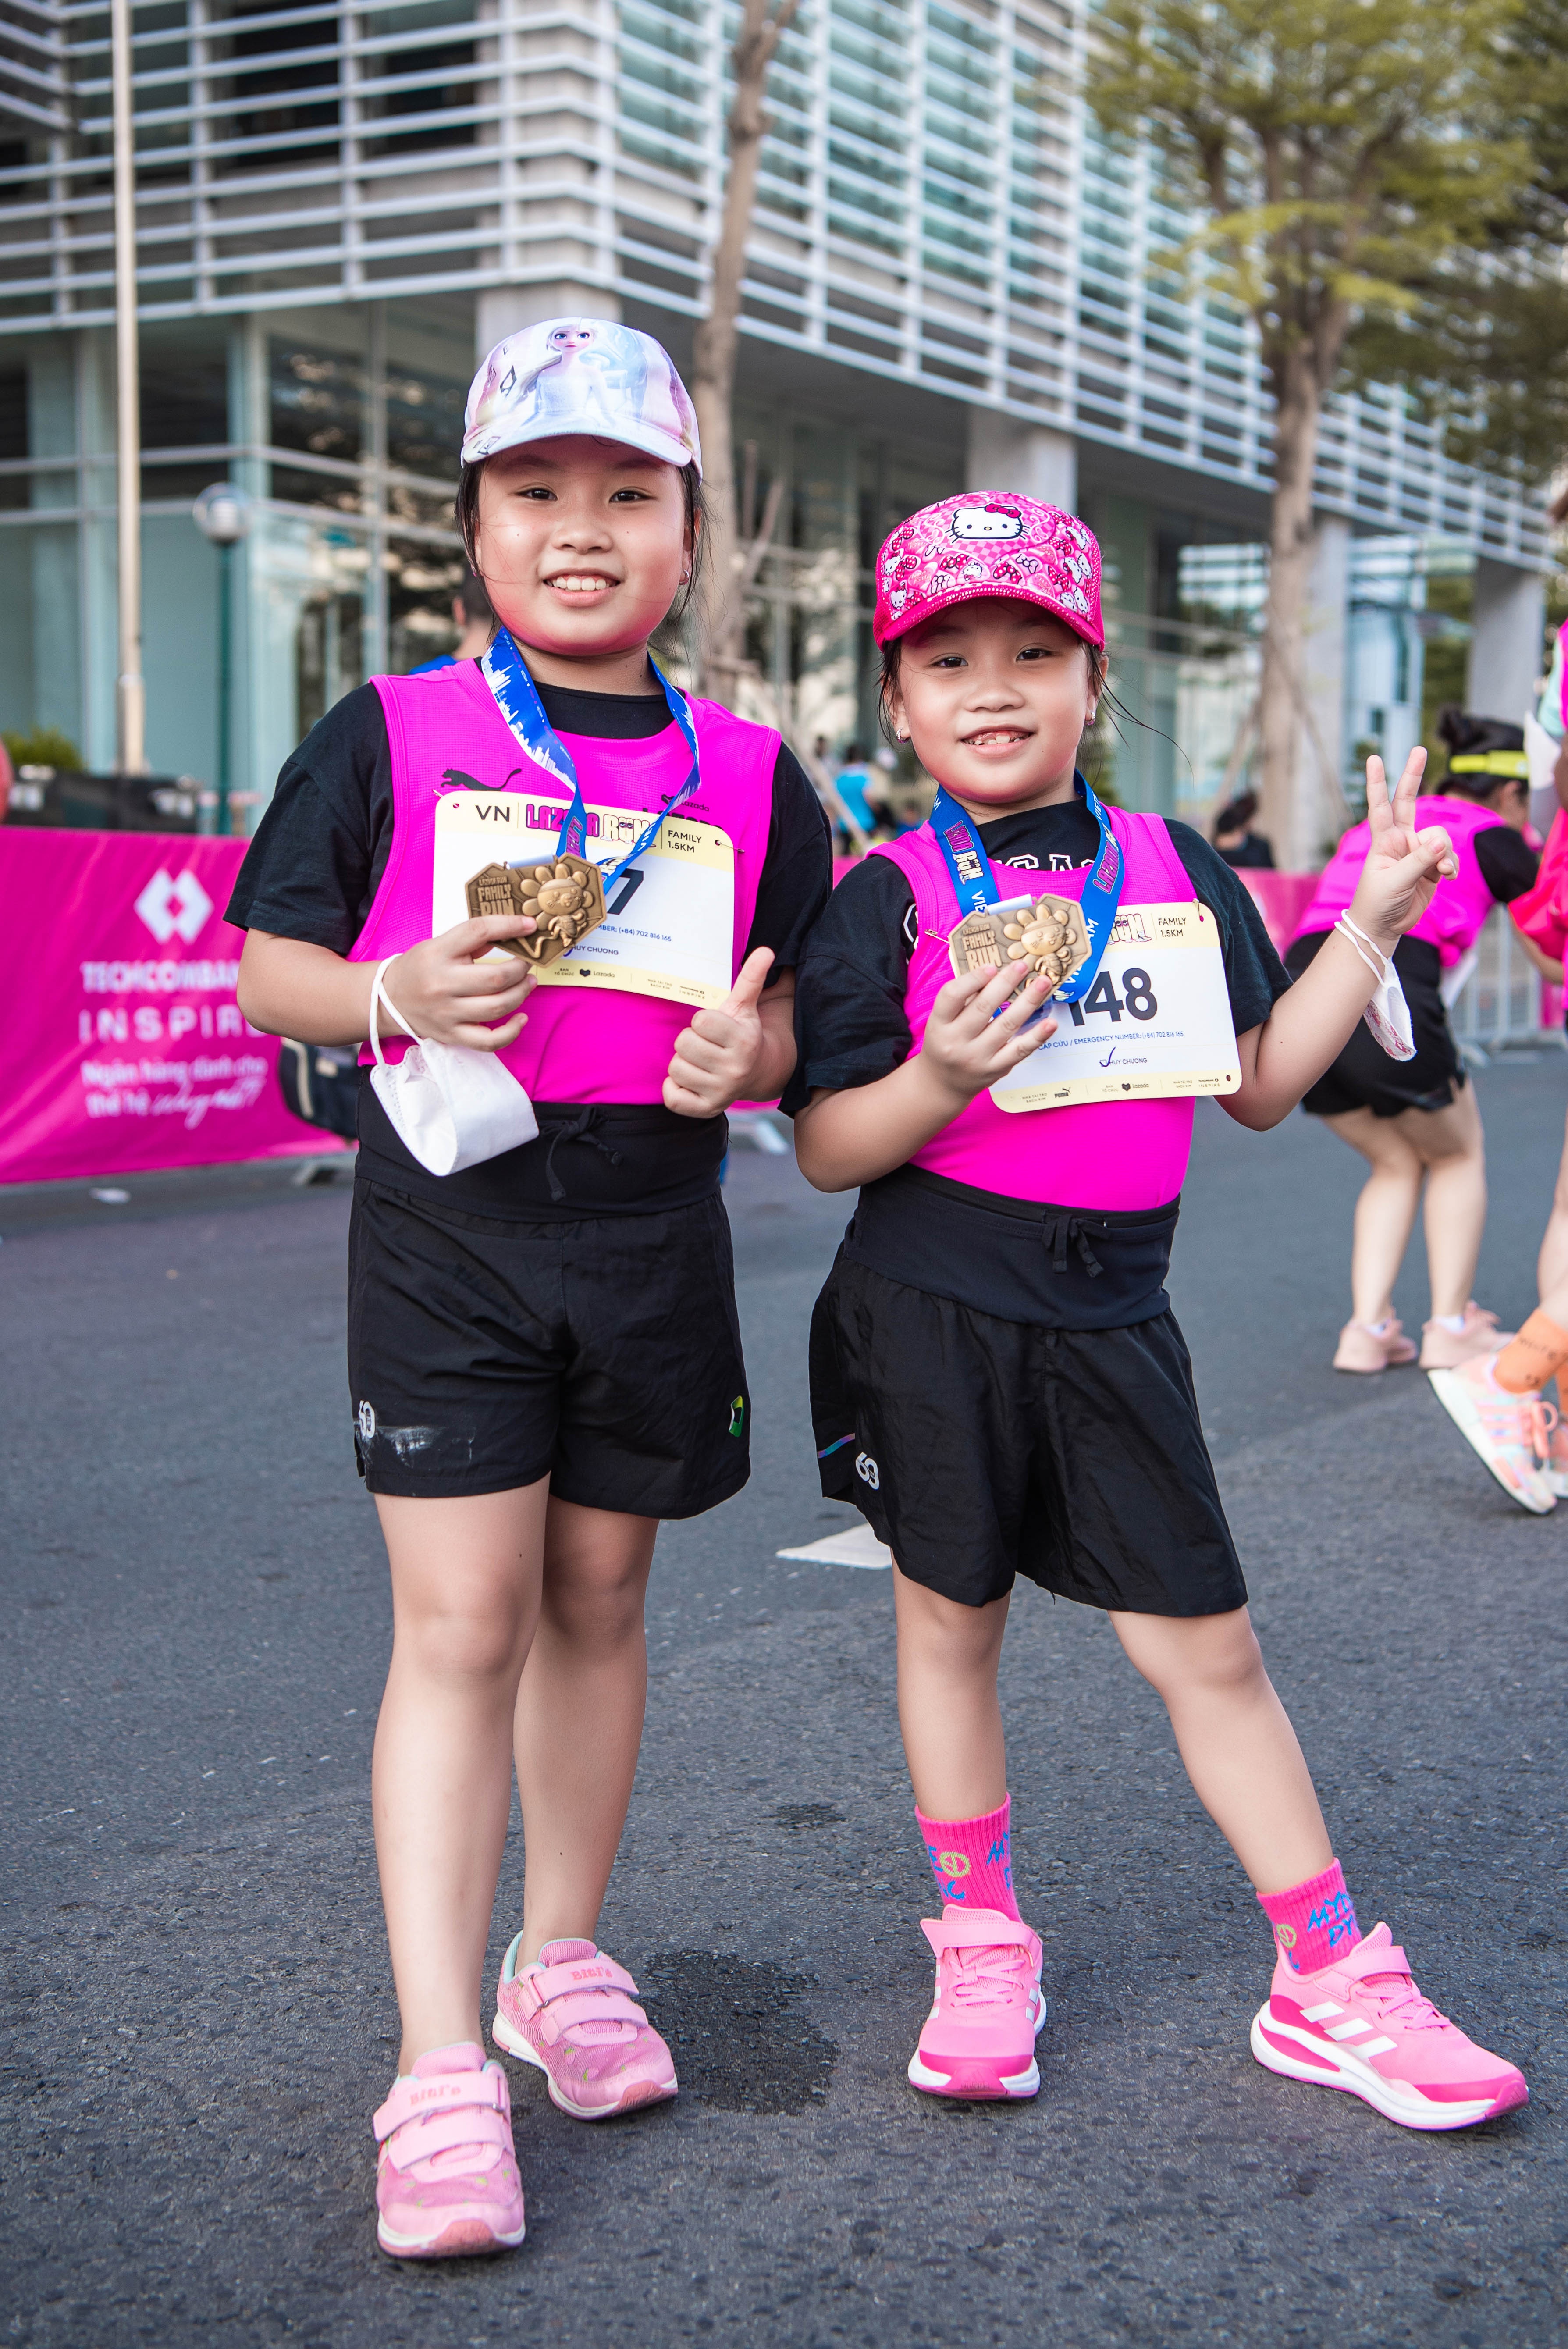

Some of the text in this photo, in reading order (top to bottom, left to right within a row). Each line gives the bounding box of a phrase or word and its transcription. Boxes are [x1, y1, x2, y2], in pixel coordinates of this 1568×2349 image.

[475, 804, 510, 822] VN
[526, 804, 600, 837] LAZA
[668, 830, 701, 844] FAMILY
[668, 841, 695, 853] 1.5KM
[477, 883, 512, 902] FAMILY
[1158, 917, 1187, 926] FAMILY
[619, 927, 635, 936] (+84)
[962, 930, 996, 952] FAMILY
[79, 1003, 269, 1043] INSPIR
[1074, 1035, 1113, 1045] EMERGENCY
